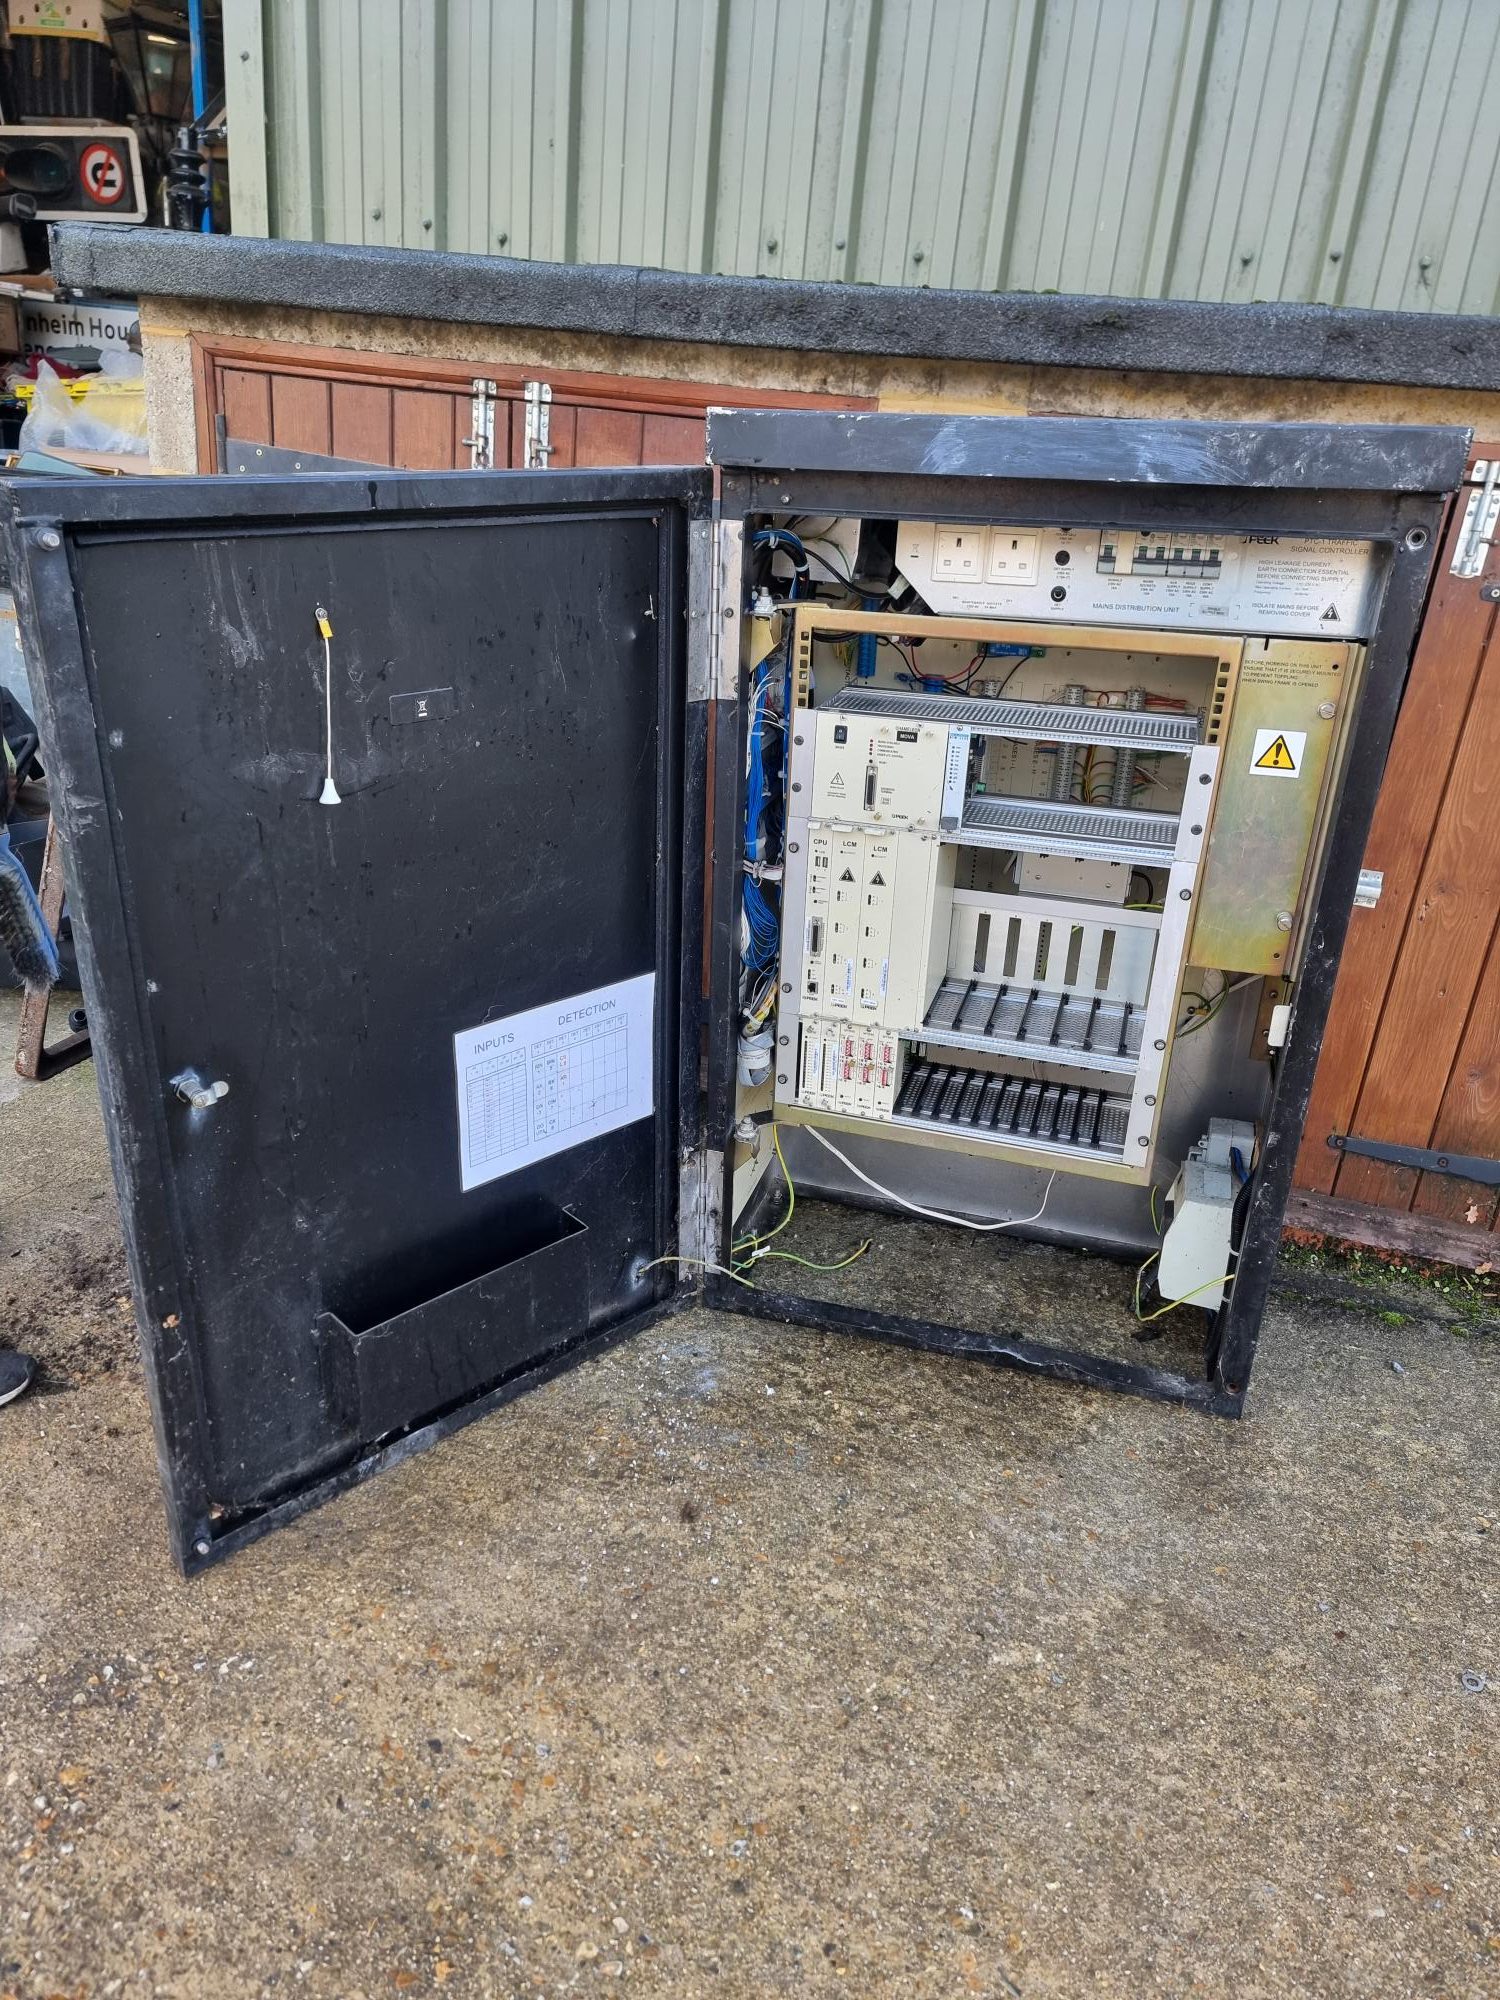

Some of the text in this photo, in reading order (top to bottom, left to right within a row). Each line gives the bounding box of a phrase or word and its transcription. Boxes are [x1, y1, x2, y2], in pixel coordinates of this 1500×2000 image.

[1278, 567, 1317, 575] CONNECTION
[1318, 568, 1349, 576] ESSENTIAL
[1281, 574, 1320, 582] CONNECTING
[1114, 604, 1162, 612] DISTRIBUTION
[1163, 606, 1180, 614] UNIT
[813, 838, 828, 847] CPU
[842, 840, 857, 848] LCM
[558, 999, 616, 1026] DETECTION
[474, 1032, 515, 1055] INPUTS
